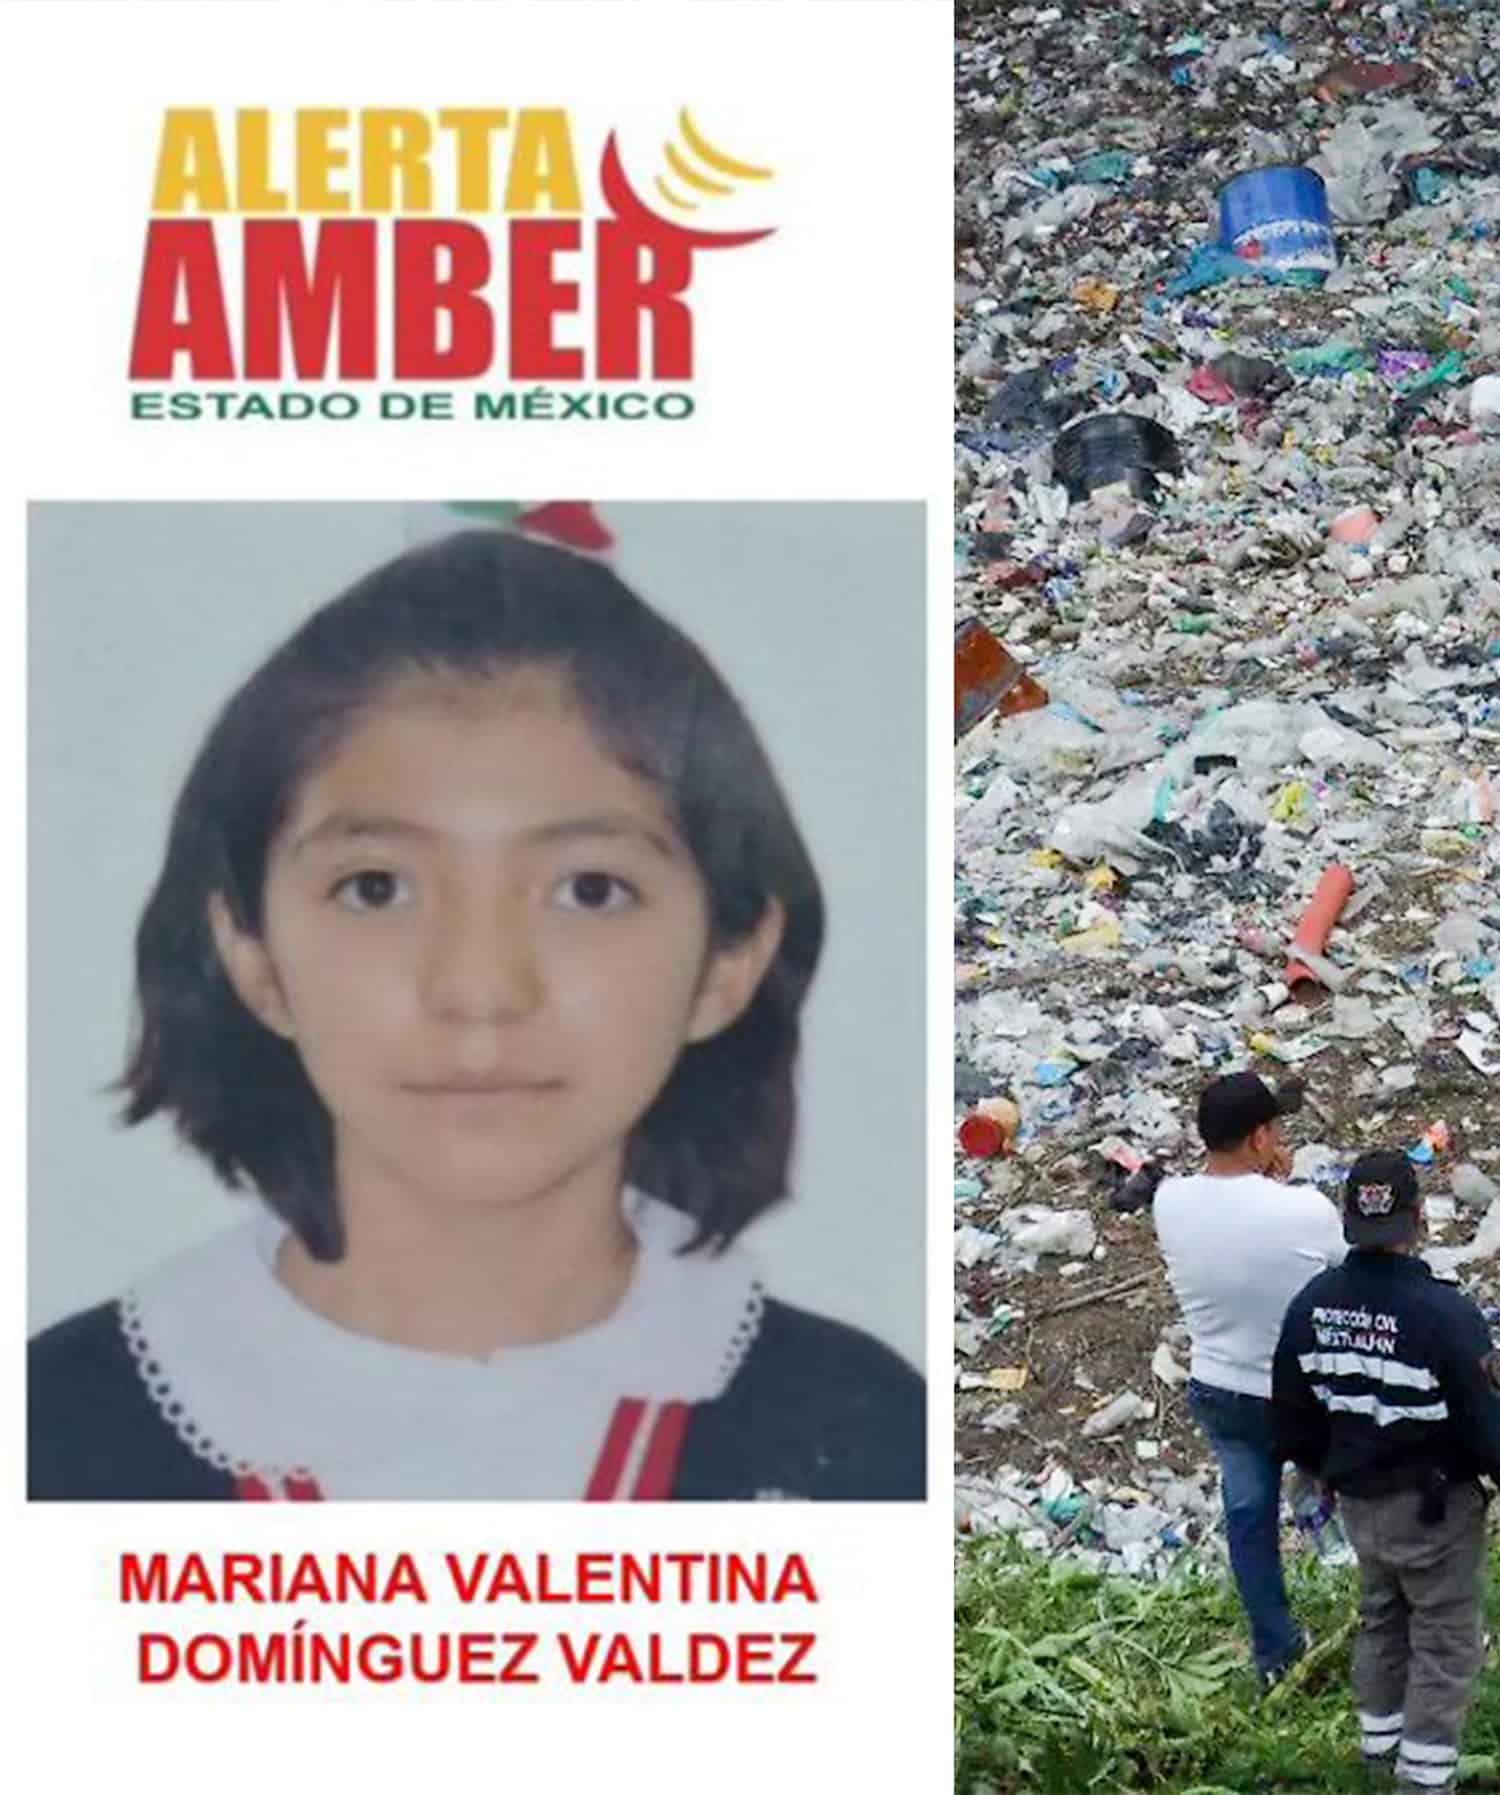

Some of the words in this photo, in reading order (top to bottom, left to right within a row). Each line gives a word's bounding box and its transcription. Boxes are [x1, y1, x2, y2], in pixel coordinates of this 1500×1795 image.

[151, 108, 583, 213] ALERTA
[128, 217, 693, 381] AMBER
[130, 392, 360, 420] ESTADO
[380, 392, 453, 420] DE
[474, 387, 696, 420] MÉXICO
[119, 1552, 428, 1604] MARIANA
[444, 1552, 819, 1604] VALENTINA
[137, 1618, 540, 1685] DOMÍNGUEZ
[556, 1632, 818, 1684] VALDEZ
